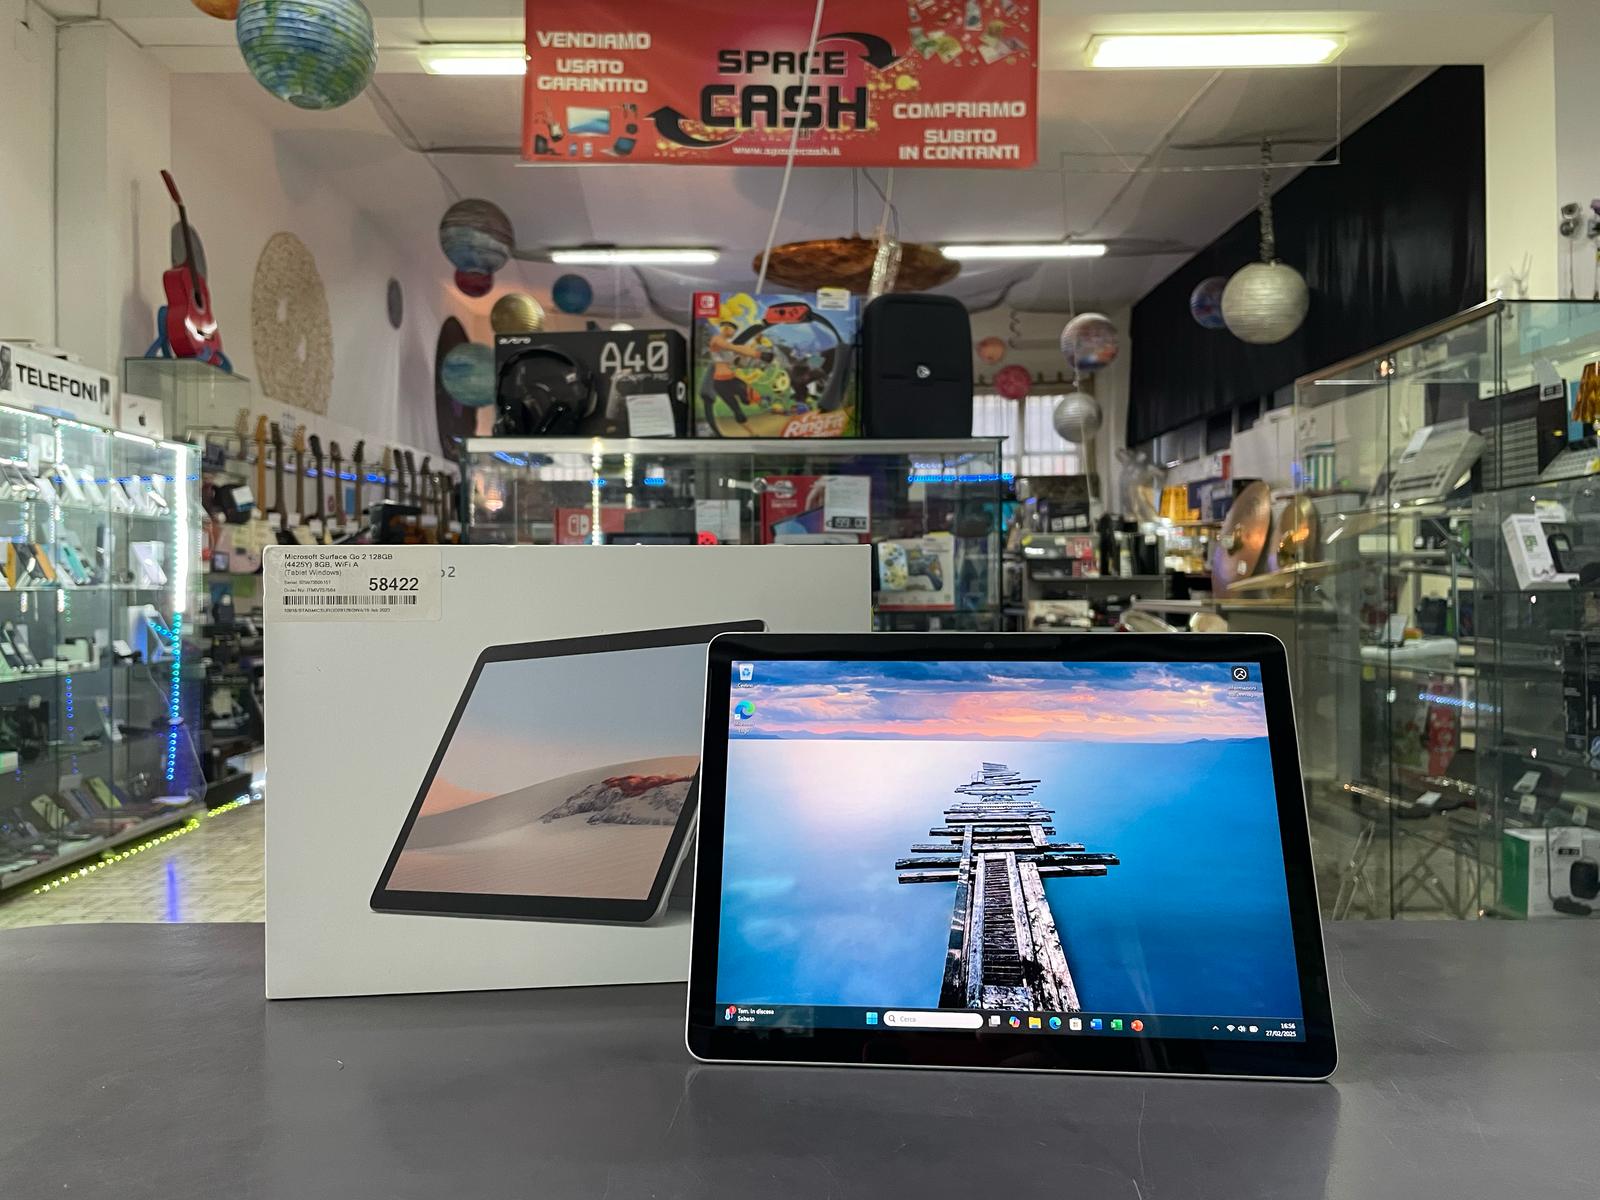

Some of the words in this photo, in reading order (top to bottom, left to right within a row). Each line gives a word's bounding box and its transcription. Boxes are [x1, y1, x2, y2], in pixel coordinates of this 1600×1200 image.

[536, 31, 652, 50] VENDIAMO
[555, 58, 624, 74] USATO
[718, 49, 845, 75] SPACE
[536, 76, 648, 93] GARANTITO
[701, 84, 868, 130] CASH
[893, 101, 1026, 119] COMPRIAMO
[923, 129, 998, 144] SUBITO
[899, 146, 919, 160] IN
[923, 144, 1020, 160] CONTANTI
[600, 341, 669, 373] A40
[16, 363, 98, 402] TELEFONI
[447, 566, 456, 578] 2
[369, 577, 419, 591] 58422
